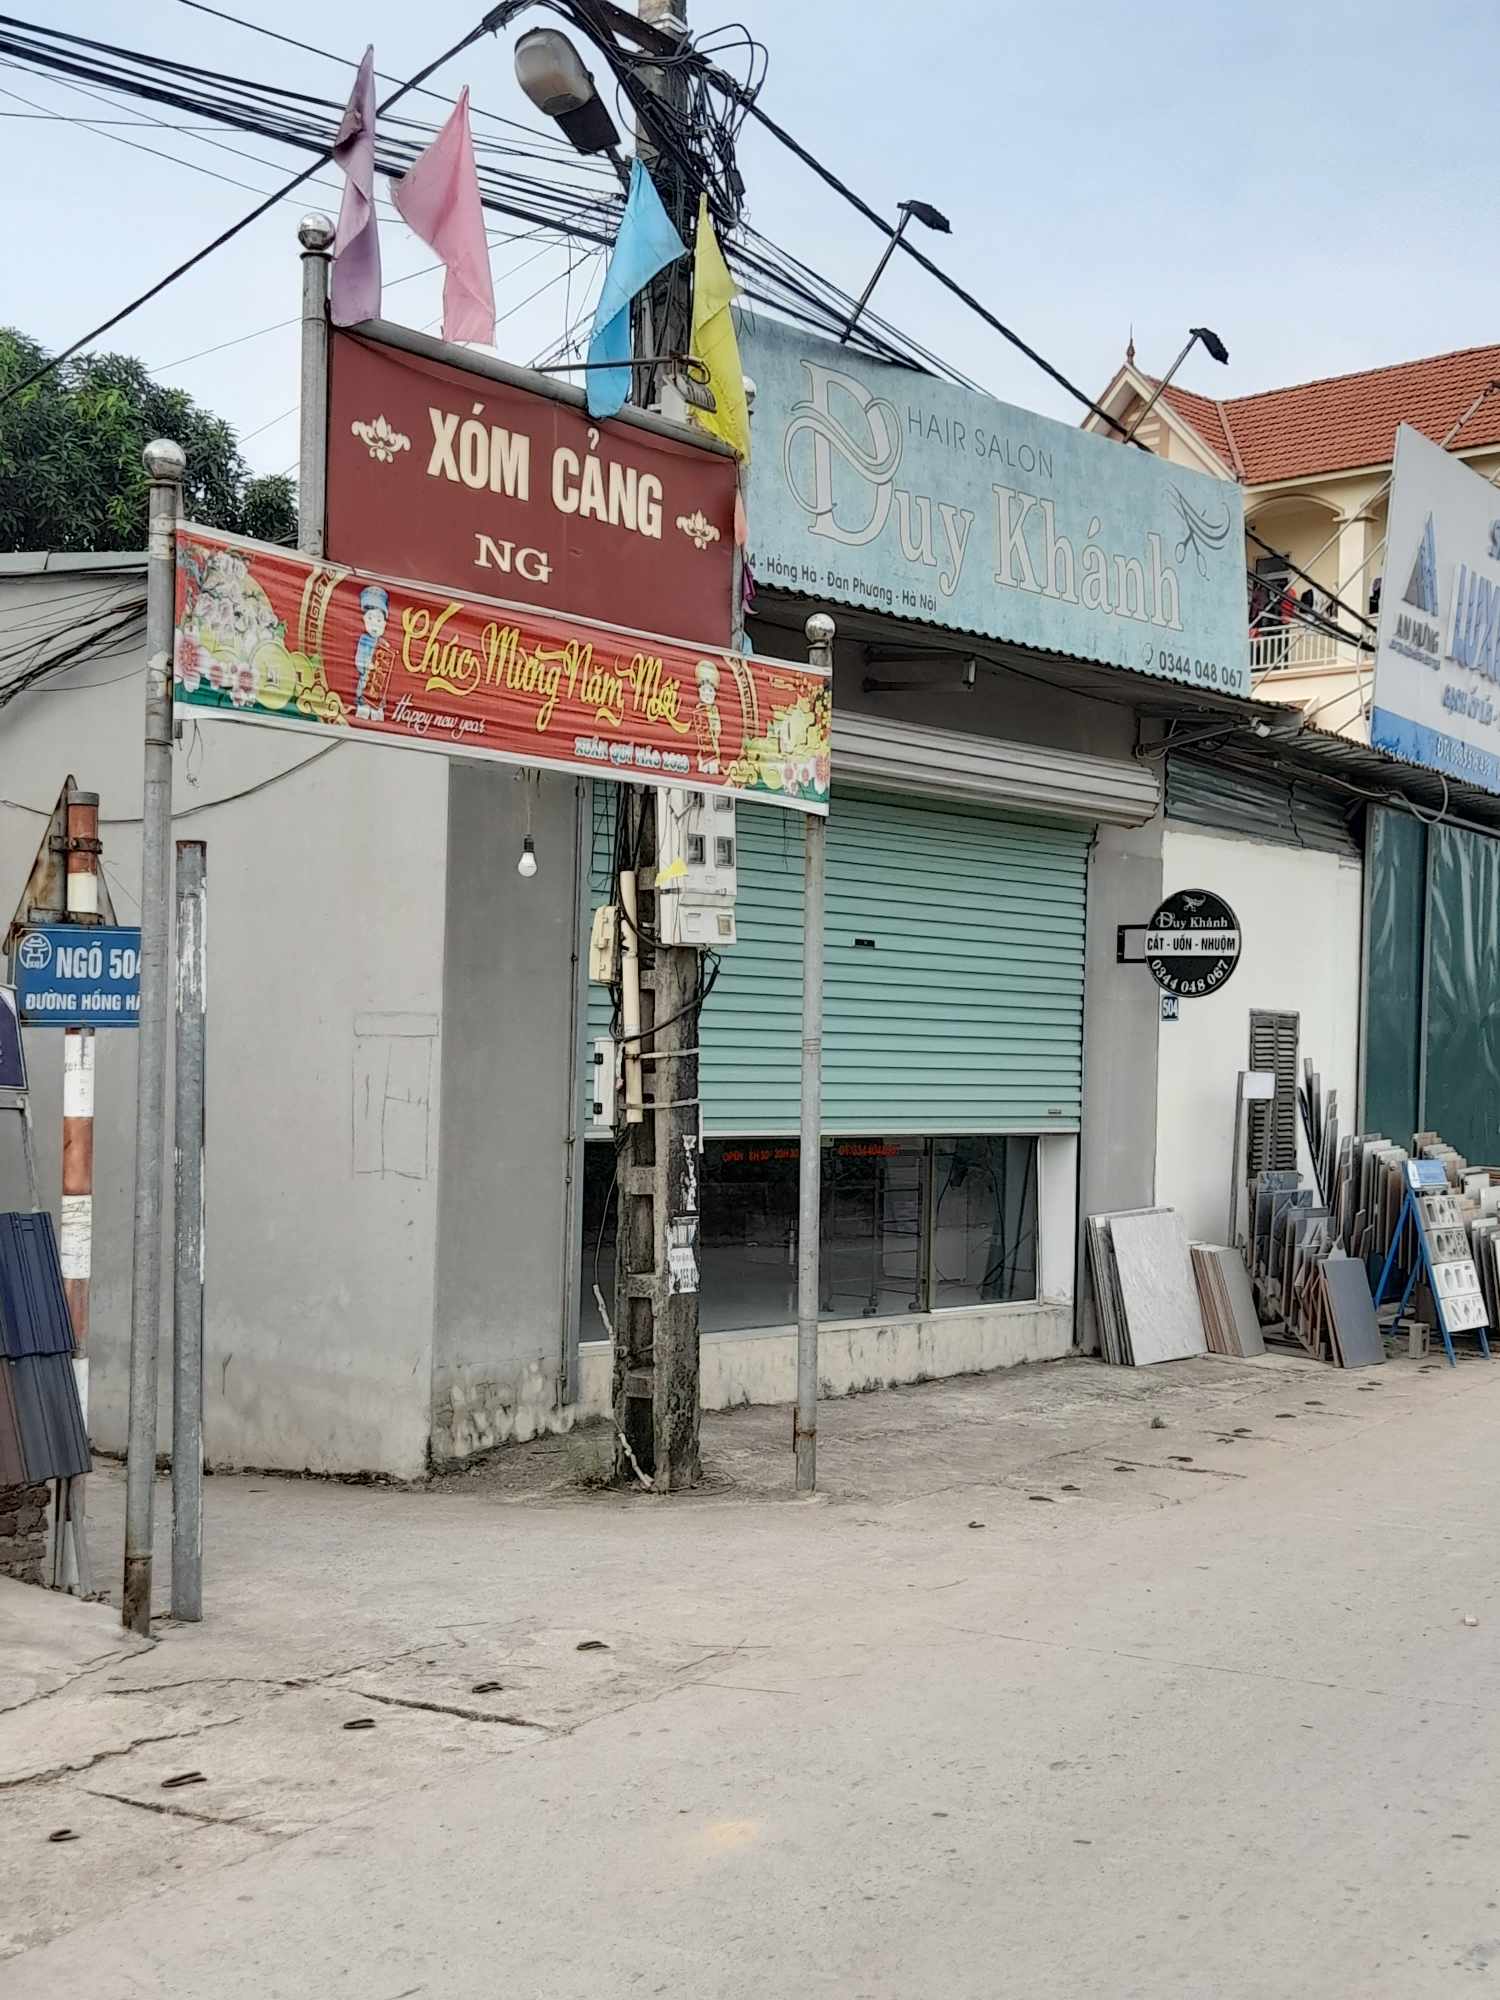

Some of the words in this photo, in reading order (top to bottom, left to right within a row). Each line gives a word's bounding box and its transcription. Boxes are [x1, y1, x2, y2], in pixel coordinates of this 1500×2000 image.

[908, 406, 965, 450] HAIR
[975, 429, 1054, 480] SALON
[427, 402, 529, 501] XÓM
[552, 427, 663, 539] CẢNG
[784, 358, 974, 597] Duy
[992, 484, 1184, 632] Khánh
[473, 532, 553, 584] NG
[767, 554, 798, 583] Hồng
[801, 564, 817, 583] Hà
[827, 572, 849, 591] Đan
[853, 577, 893, 605] Phương
[902, 588, 917, 607] Hà
[920, 594, 937, 615] Nội
[402, 602, 481, 696] Chúc
[481, 622, 560, 732] Mừng
[535, 639, 624, 727] Năm
[615, 653, 691, 734] Mới
[1159, 651, 1191, 676] 0344
[1194, 659, 1218, 683] 048
[1221, 666, 1243, 688] 067
[392, 694, 432, 734] Happy
[434, 715, 458, 728] new
[1155, 911, 1187, 930] Duy
[1190, 916, 1228, 929] Khánh
[56, 940, 103, 980] NGÕ
[1147, 933, 1164, 951] CẮT
[1173, 933, 1192, 951] UỐN
[1201, 934, 1235, 953] NHUỘM
[1151, 959, 1179, 990] 0344
[1181, 979, 1206, 993] 048
[1207, 959, 1229, 985] 067
[25, 989, 77, 1011] ĐƯỜNG
[1162, 998, 1178, 1017] 504
